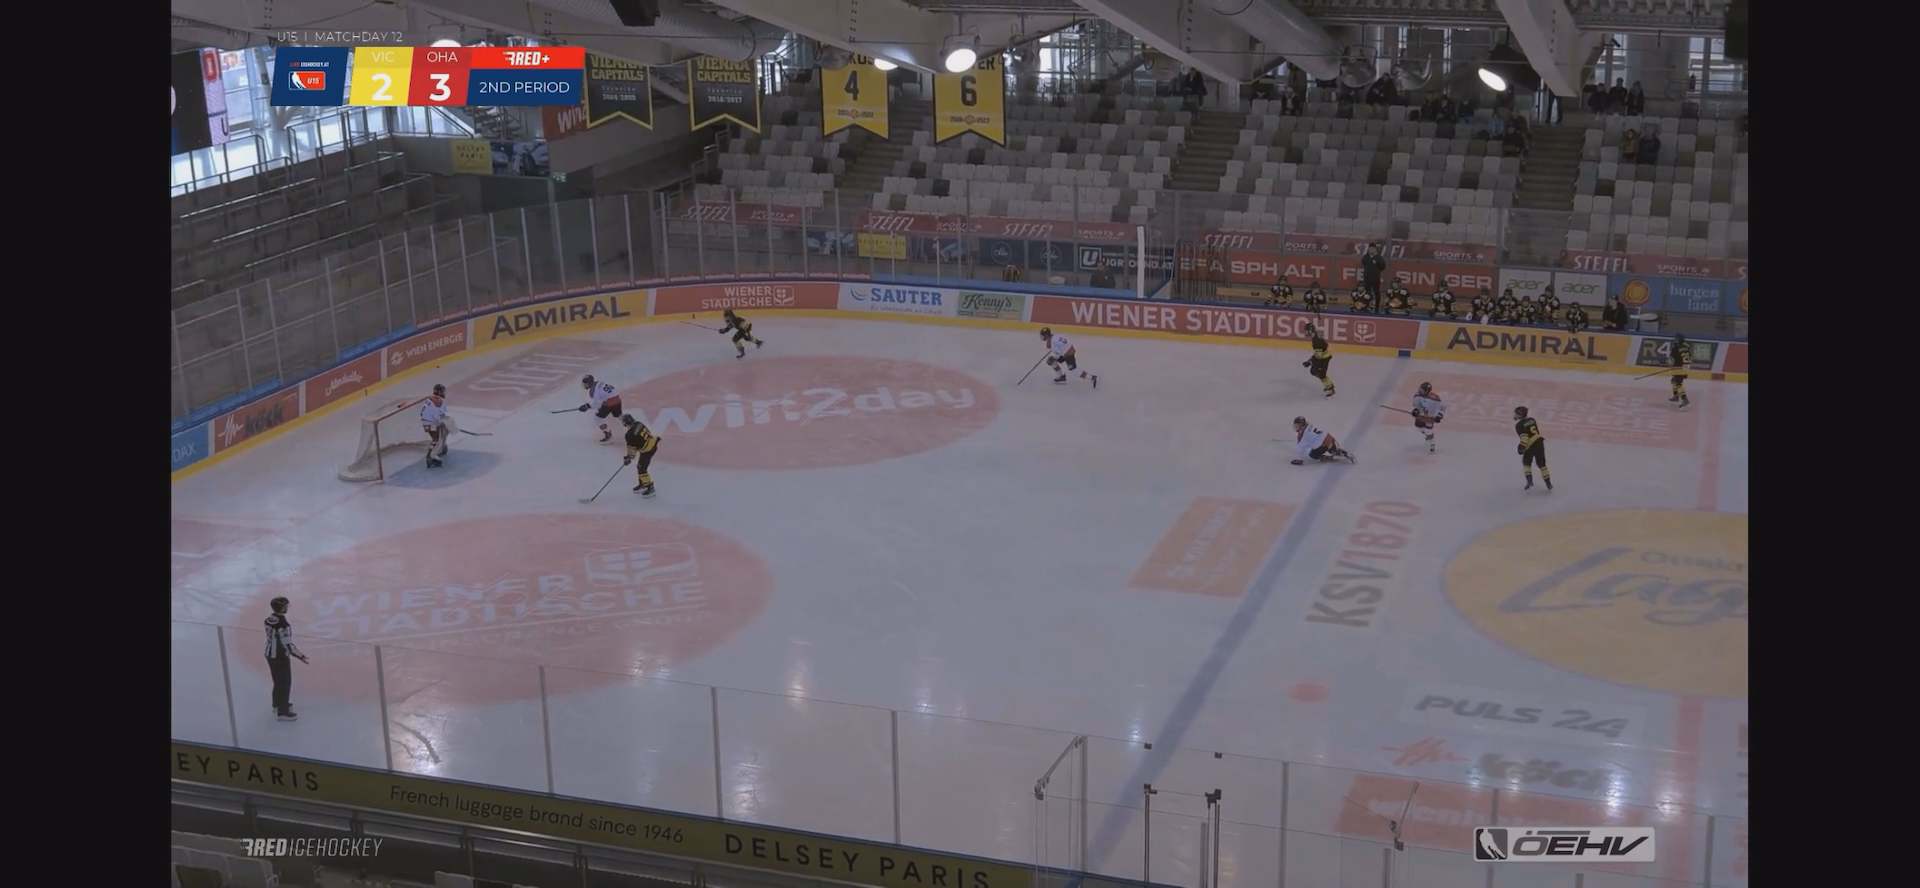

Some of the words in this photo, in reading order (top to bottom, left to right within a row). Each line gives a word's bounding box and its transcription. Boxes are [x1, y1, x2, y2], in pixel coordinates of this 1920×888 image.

[591, 69, 644, 82] CAPITALS
[696, 70, 751, 84] CAPITALS
[843, 69, 860, 102] 4
[960, 74, 978, 107] 6
[724, 285, 773, 297] WIENER
[871, 287, 943, 307] SAUTER
[1506, 277, 1544, 291] acer
[1561, 282, 1600, 295] acer
[1670, 283, 1719, 301] burgen
[490, 296, 631, 340] ADMIRAL
[701, 296, 773, 310] STÄDTISCHE
[961, 293, 1013, 313] Kenny's
[1687, 298, 1719, 312] land
[1070, 301, 1177, 330] WIENER
[1186, 308, 1348, 341] STÄDTISCHE
[405, 343, 428, 359] WIEN
[427, 332, 464, 352] ENERGIE
[1447, 326, 1608, 362] ADMIRAL
[630, 385, 977, 434] win2day
[1304, 500, 1422, 628] KSV1870
[309, 573, 577, 618] WIENER
[1414, 694, 1544, 725] PULS
[1551, 708, 1629, 739] 24
[227, 759, 320, 792] PARIS
[390, 784, 450, 809] French
[455, 794, 524, 823] luggage
[529, 805, 584, 828] brand
[588, 815, 637, 837] since
[643, 823, 685, 844] 1946
[724, 833, 860, 873] DELSEY
[879, 856, 989, 888] PARIS
